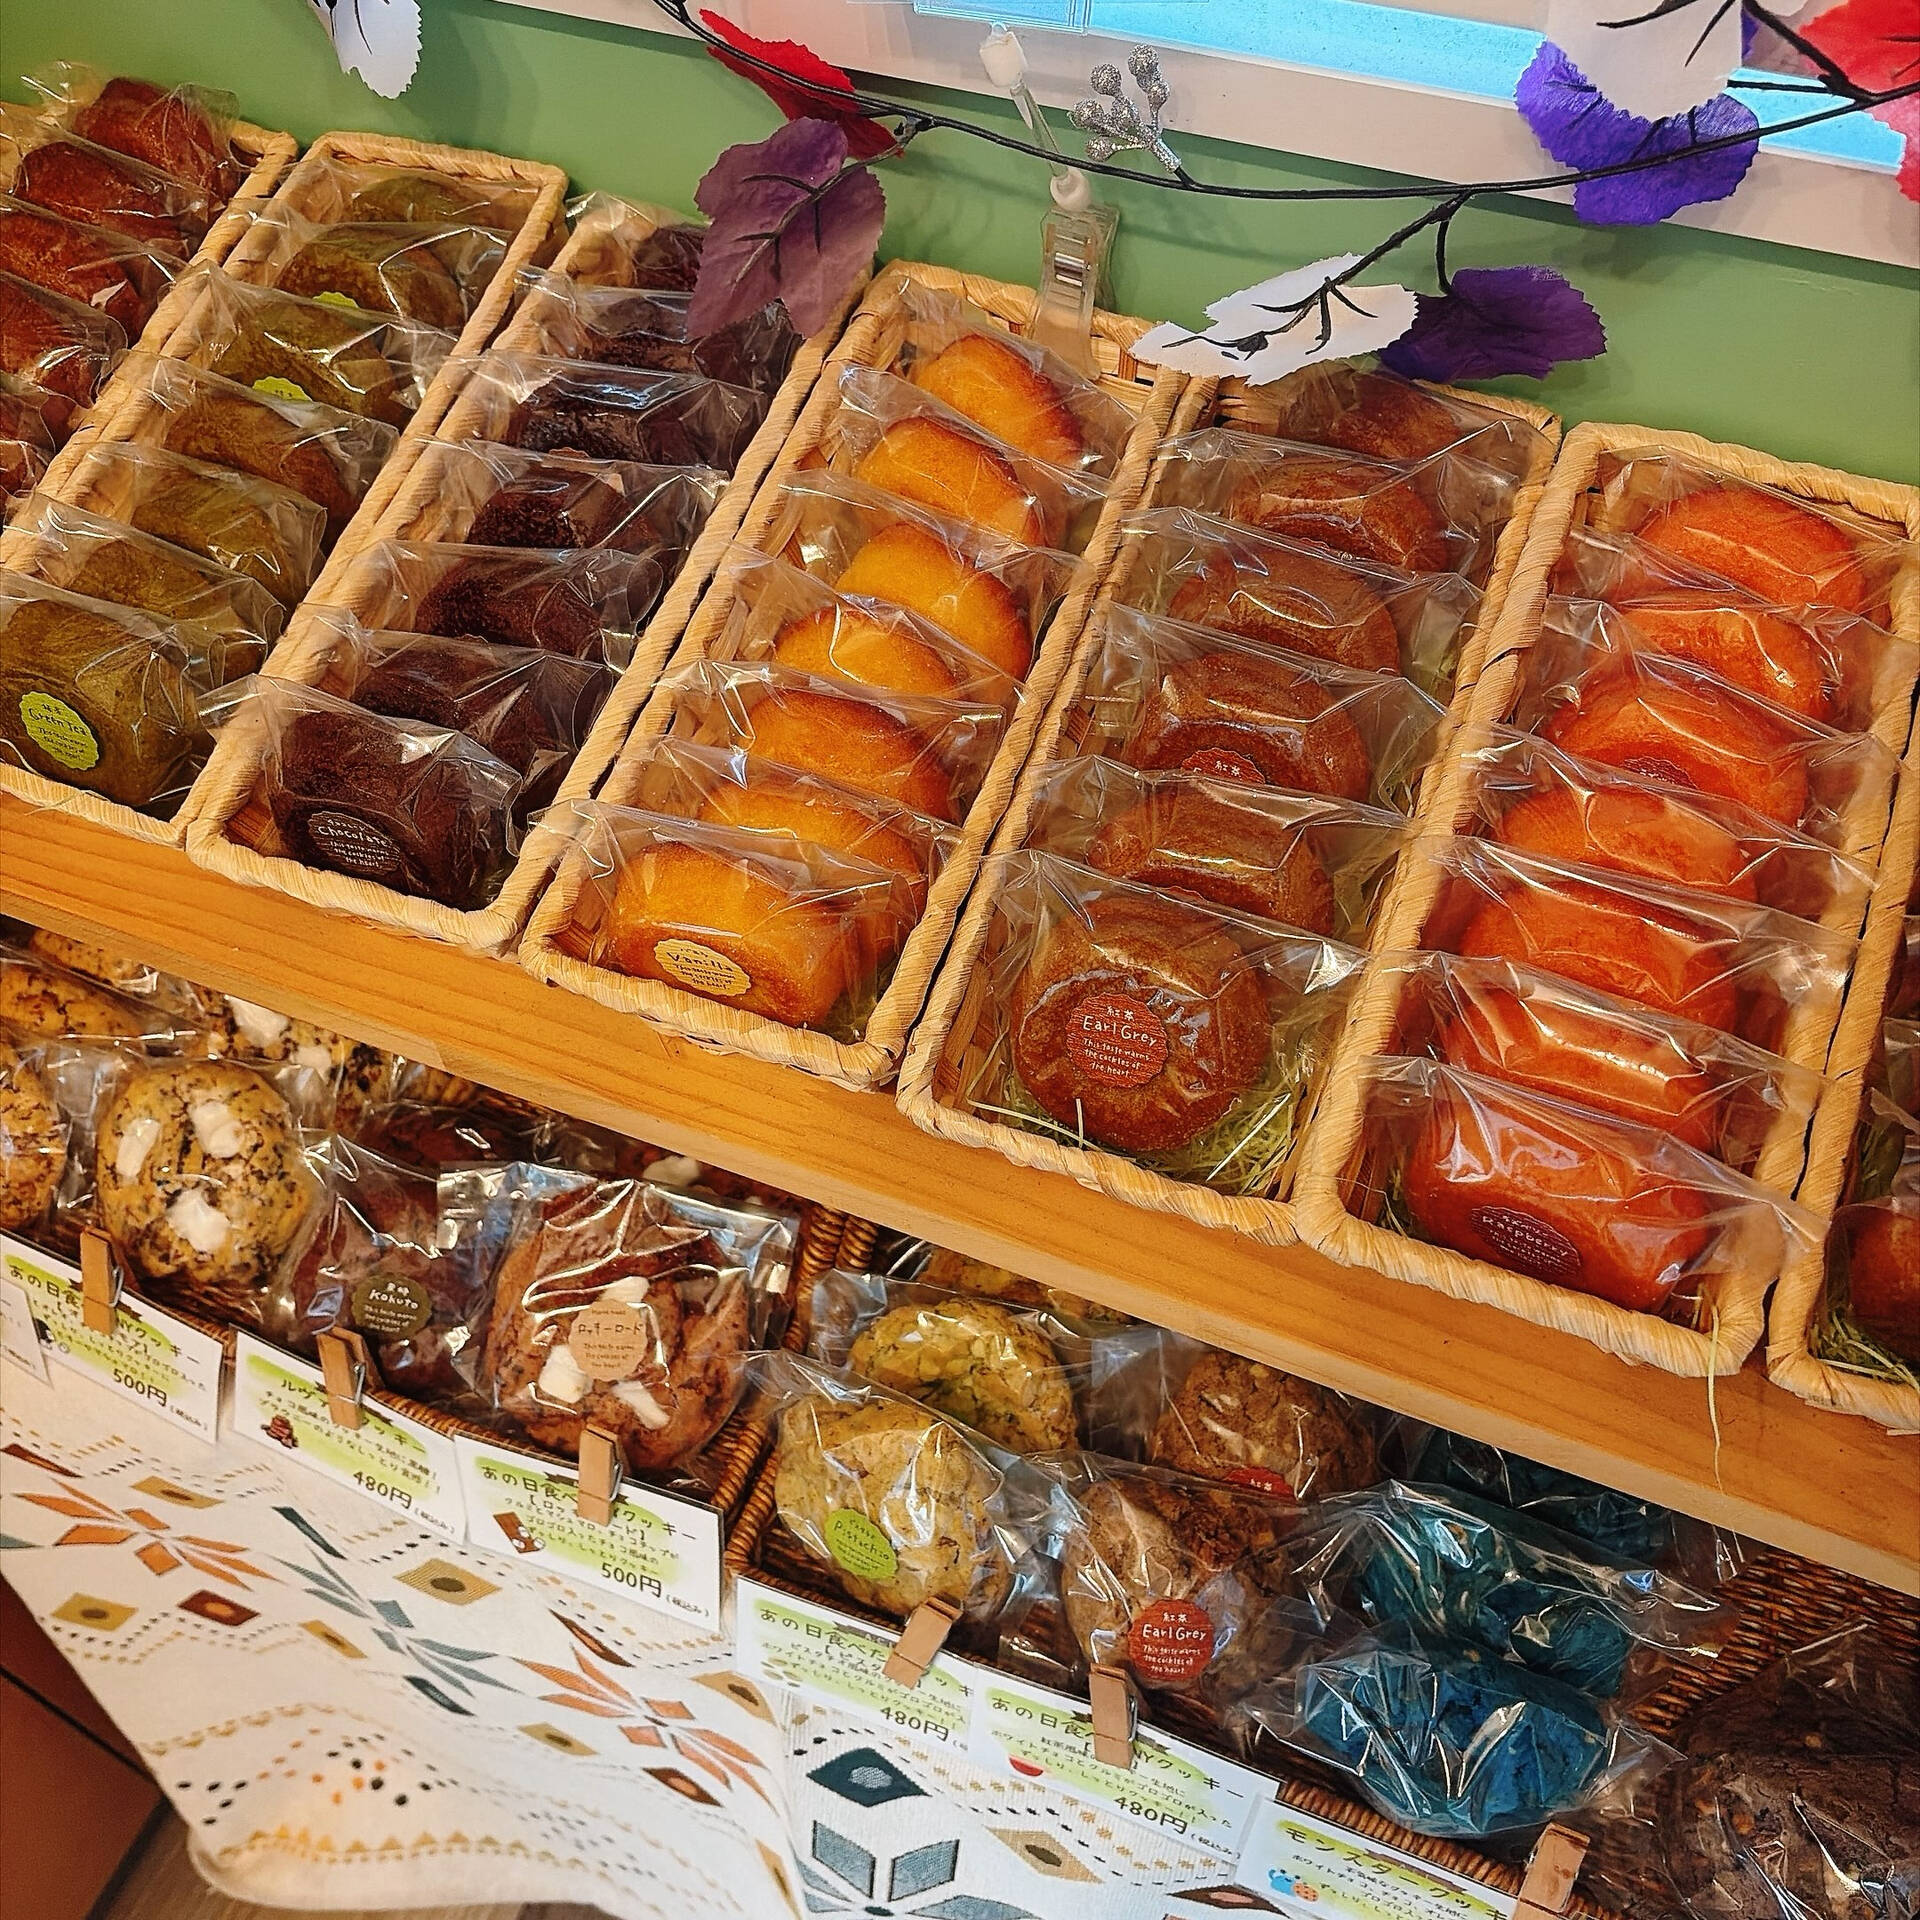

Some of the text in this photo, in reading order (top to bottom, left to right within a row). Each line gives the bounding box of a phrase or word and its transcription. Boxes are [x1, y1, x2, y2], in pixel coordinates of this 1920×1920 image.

[28, 708, 87, 736] Green Tea
[317, 826, 388, 847] Chocolate
[666, 951, 733, 972] Vanilla
[1107, 1005, 1134, 1021] 紅茶
[1083, 1015, 1157, 1047] Earl Grey
[1083, 1038, 1151, 1061] This taste warms
[1085, 1048, 1141, 1069] the cockles of
[1090, 1062, 1104, 1071] the
[1482, 1215, 1569, 1257] Raspberry
[369, 1289, 418, 1309] Kokuto
[9, 1263, 200, 1367] あの日食NYクッキー
[113, 1367, 166, 1408] 500円
[353, 1469, 412, 1511] 480円
[833, 1520, 889, 1560] Pistachio
[601, 1563, 661, 1598] 500円
[1163, 1611, 1188, 1623] 紅茶
[1142, 1623, 1206, 1640] Earl Grey
[1143, 1645, 1158, 1653] This
[880, 1705, 949, 1742] 480円
[991, 1698, 1246, 1800] あの日食NYクッキー
[1112, 1796, 1189, 1835] 480円
